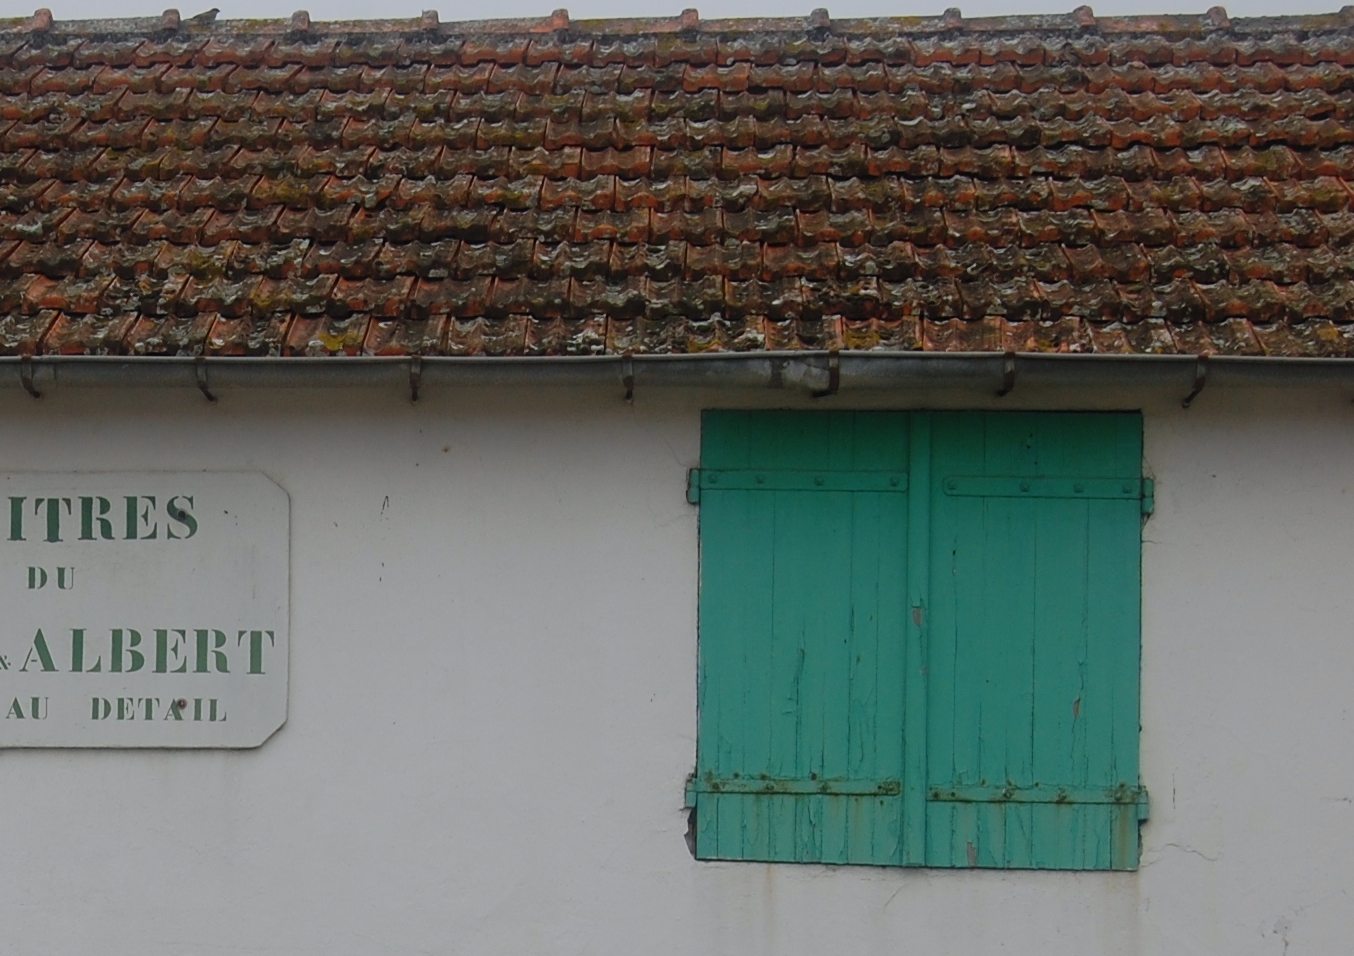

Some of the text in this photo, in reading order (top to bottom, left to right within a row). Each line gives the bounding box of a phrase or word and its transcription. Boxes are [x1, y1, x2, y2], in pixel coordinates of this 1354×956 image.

[27, 566, 76, 590] DU
[19, 628, 275, 675] ALBERT
[6, 696, 49, 720] AU
[90, 696, 227, 722] DETAIL
